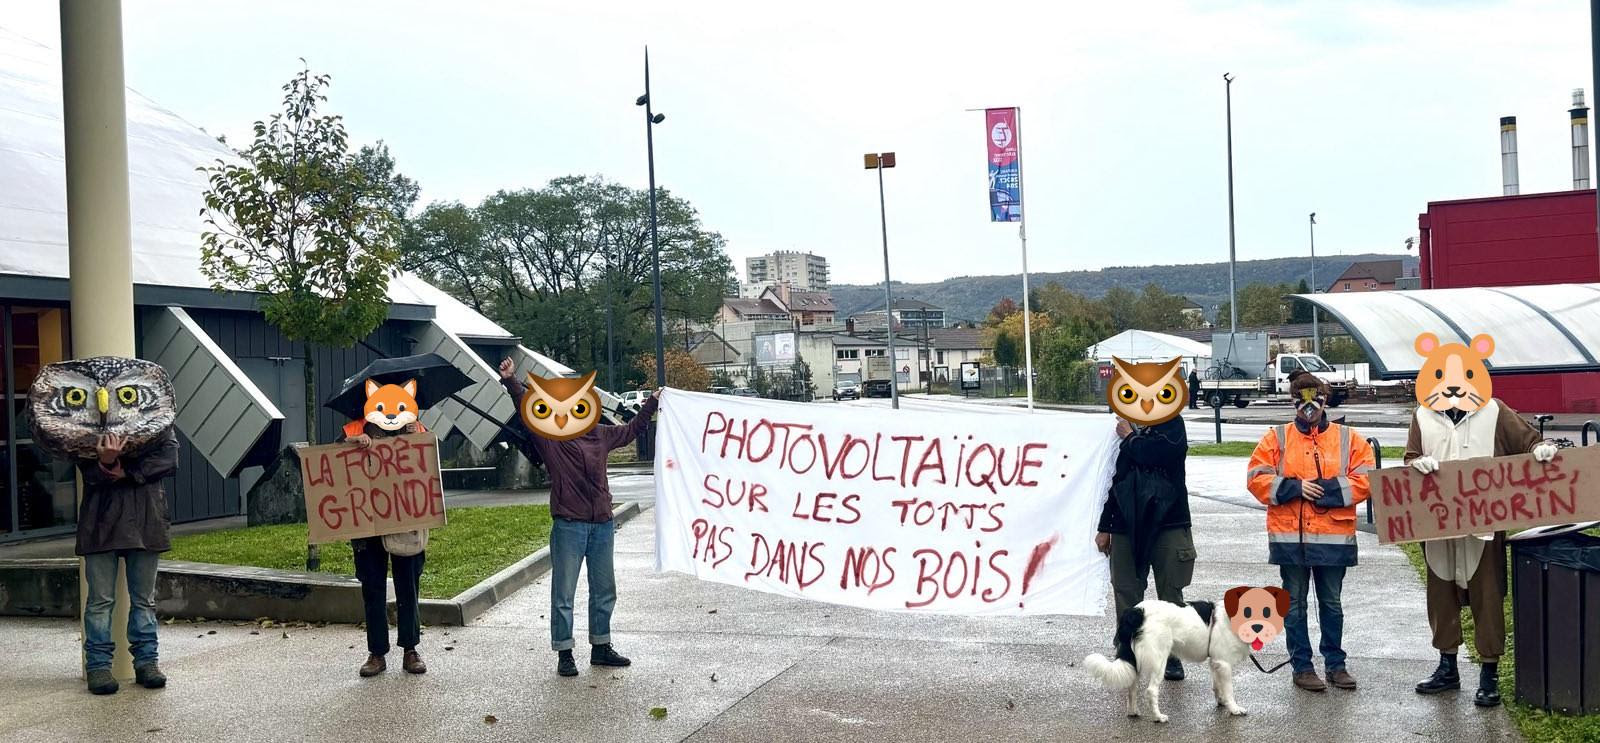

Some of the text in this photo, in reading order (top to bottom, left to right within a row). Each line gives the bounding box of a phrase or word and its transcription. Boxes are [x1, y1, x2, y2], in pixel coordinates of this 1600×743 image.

[305, 453, 334, 487] LA
[318, 476, 444, 530] GRONDE
[702, 474, 768, 512] SUR
[792, 492, 861, 523] LES
[1387, 510, 1415, 542] NI
[692, 518, 734, 569] PAS
[745, 533, 825, 590] DANS
[840, 546, 897, 595] NOS
